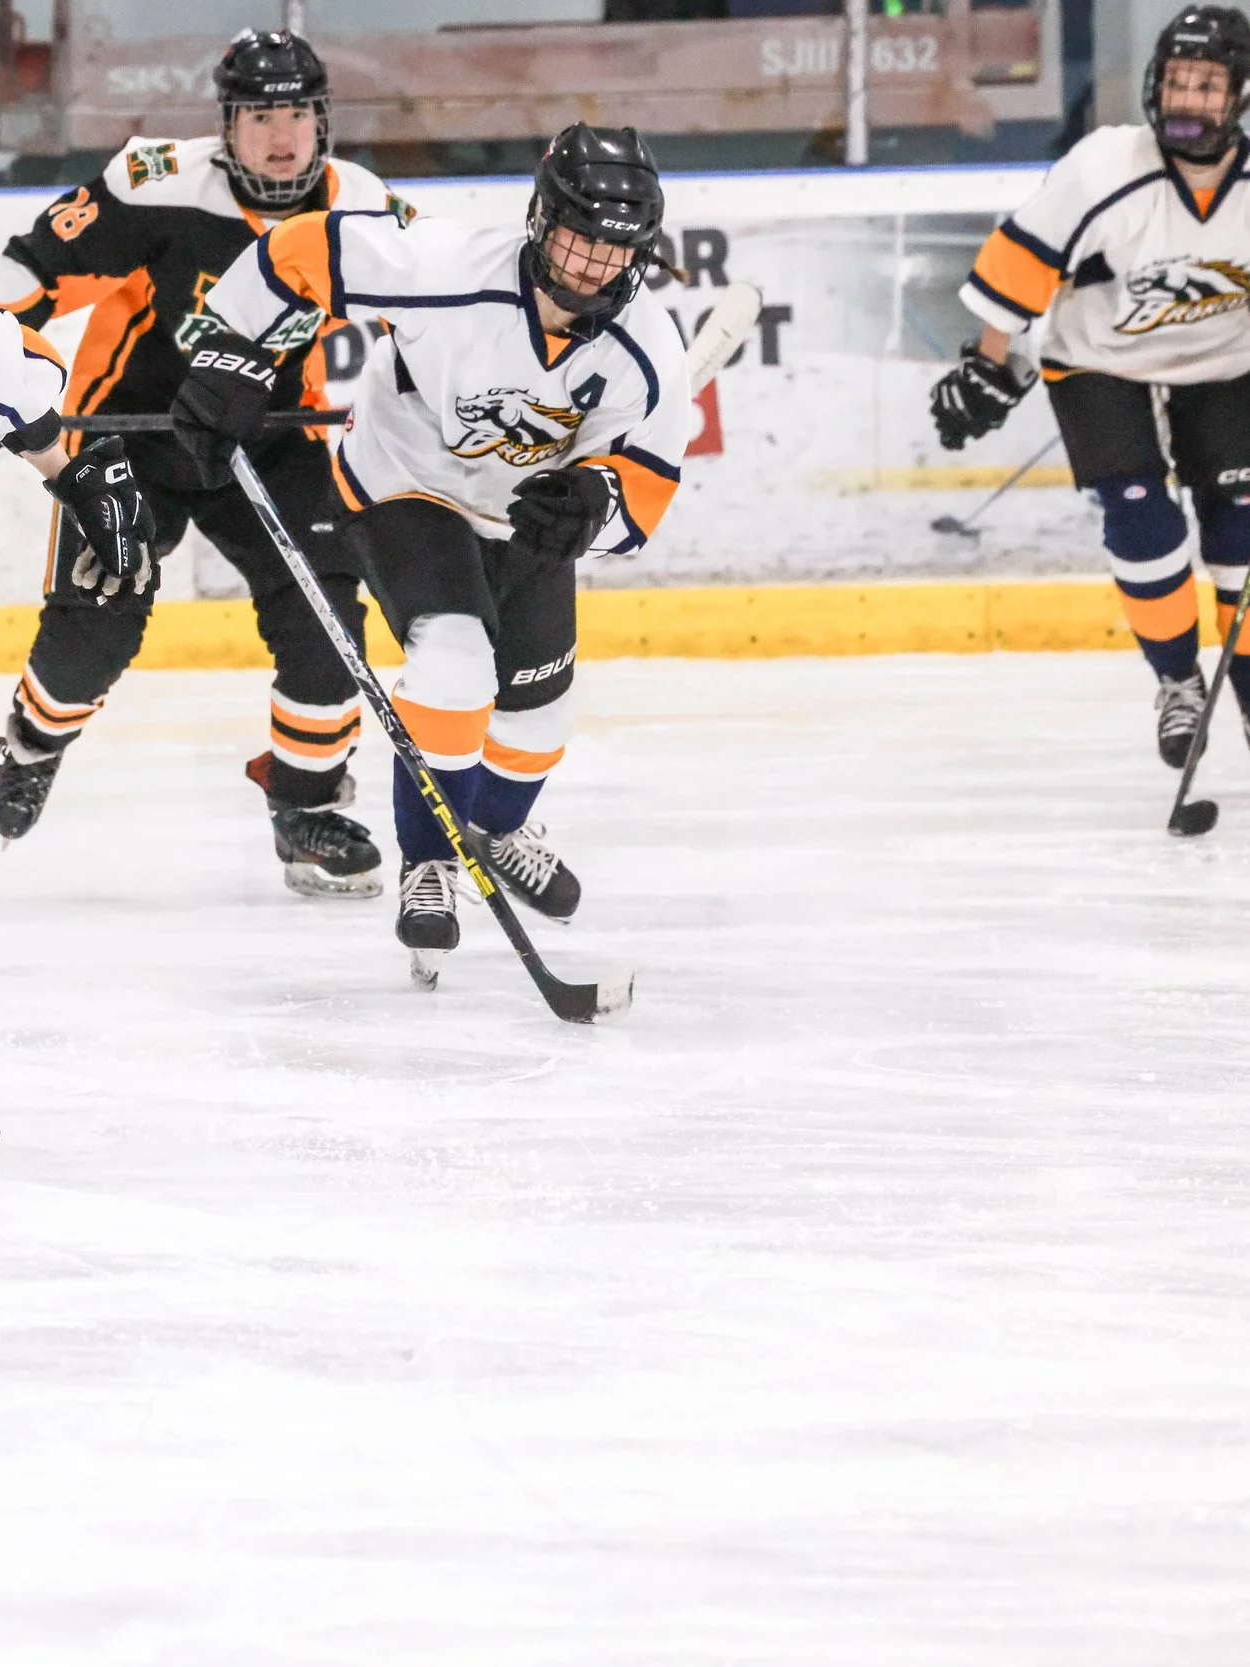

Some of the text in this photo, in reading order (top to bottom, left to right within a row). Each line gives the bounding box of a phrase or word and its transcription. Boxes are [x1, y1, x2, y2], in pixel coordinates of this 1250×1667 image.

[263, 81, 303, 93] CCM
[600, 218, 641, 232] CCM
[570, 372, 608, 413] A
[121, 537, 129, 568] CCM
[420, 768, 496, 899] TRUE
